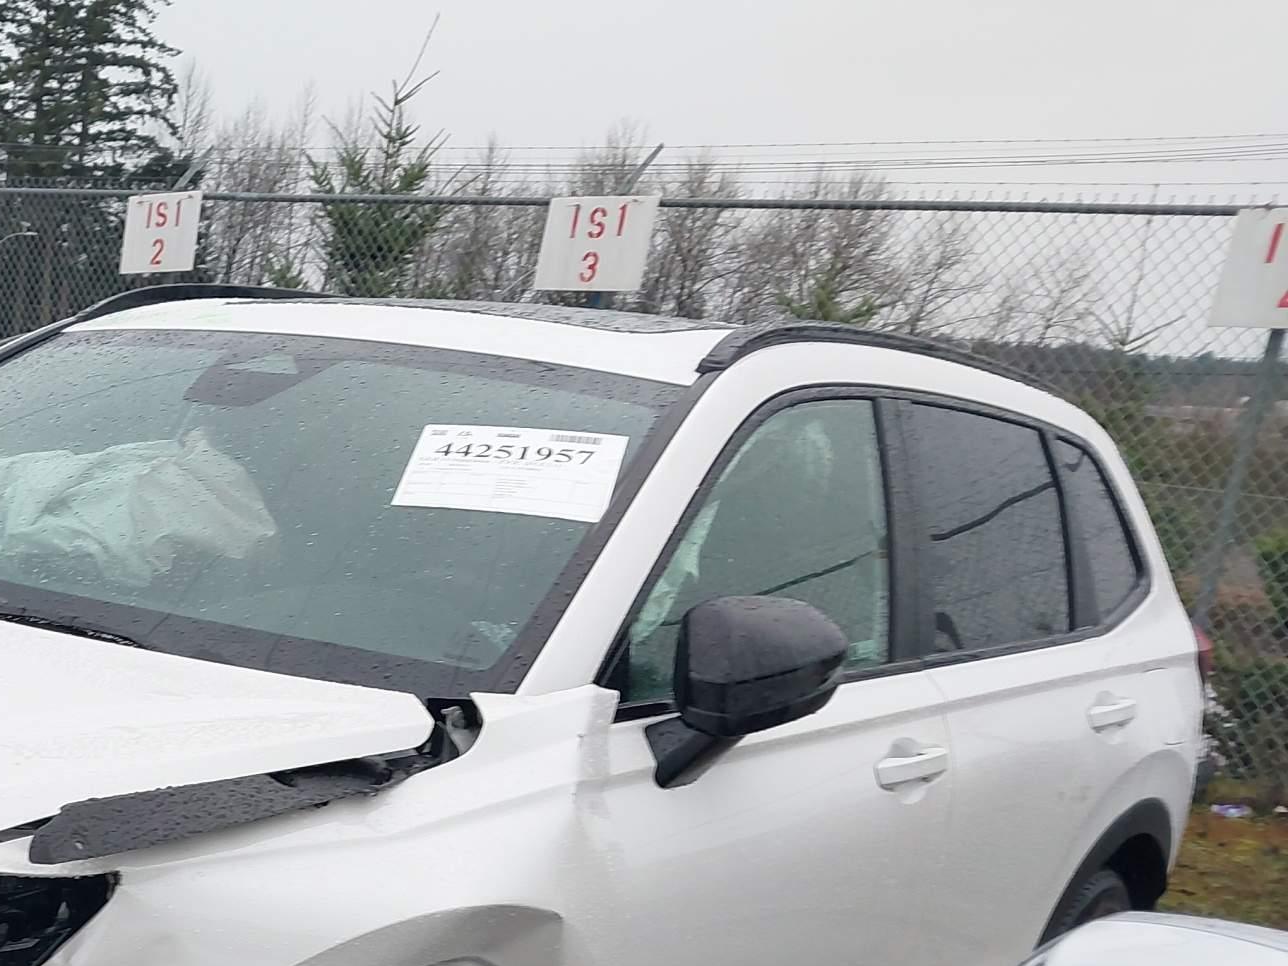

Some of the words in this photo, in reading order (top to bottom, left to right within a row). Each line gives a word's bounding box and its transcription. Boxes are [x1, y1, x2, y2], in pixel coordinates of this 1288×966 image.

[150, 238, 165, 265] 2
[579, 251, 600, 283] 3
[434, 442, 597, 465] 44251957
